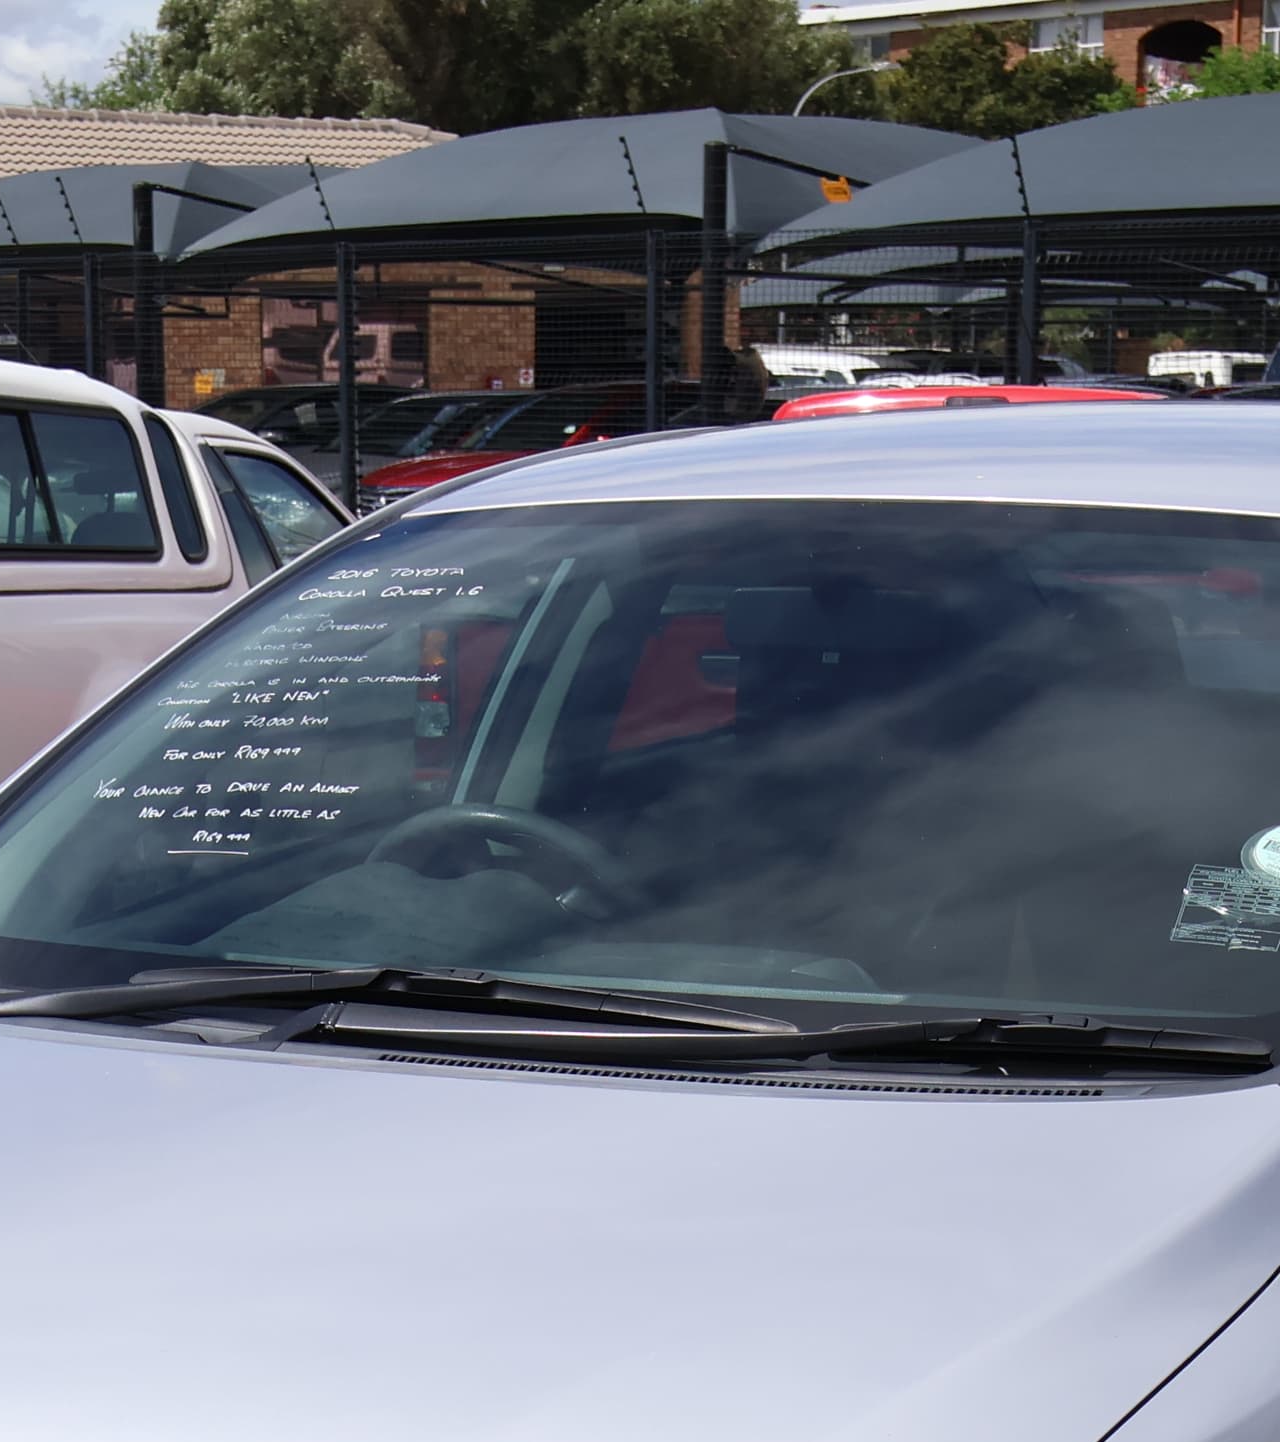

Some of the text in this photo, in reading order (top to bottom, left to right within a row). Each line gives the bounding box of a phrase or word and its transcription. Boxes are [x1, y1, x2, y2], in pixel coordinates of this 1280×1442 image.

[327, 567, 465, 580] 2016 TOYOTA
[298, 585, 484, 601] COROLLA QUEST 1.6
[198, 719, 231, 728] ONLY
[163, 749, 189, 760] FOR
[192, 751, 226, 760] ONLY
[93, 777, 125, 799] YOUR
[195, 784, 212, 794] TO
[227, 781, 271, 793] DRIVE
[280, 783, 305, 793] AN
[309, 783, 360, 794] ALMOST
[138, 807, 165, 819] NEW
[205, 808, 229, 818] FOR
[240, 808, 263, 818] AS
[269, 808, 312, 818] LITTLE
[316, 809, 341, 820] AS
